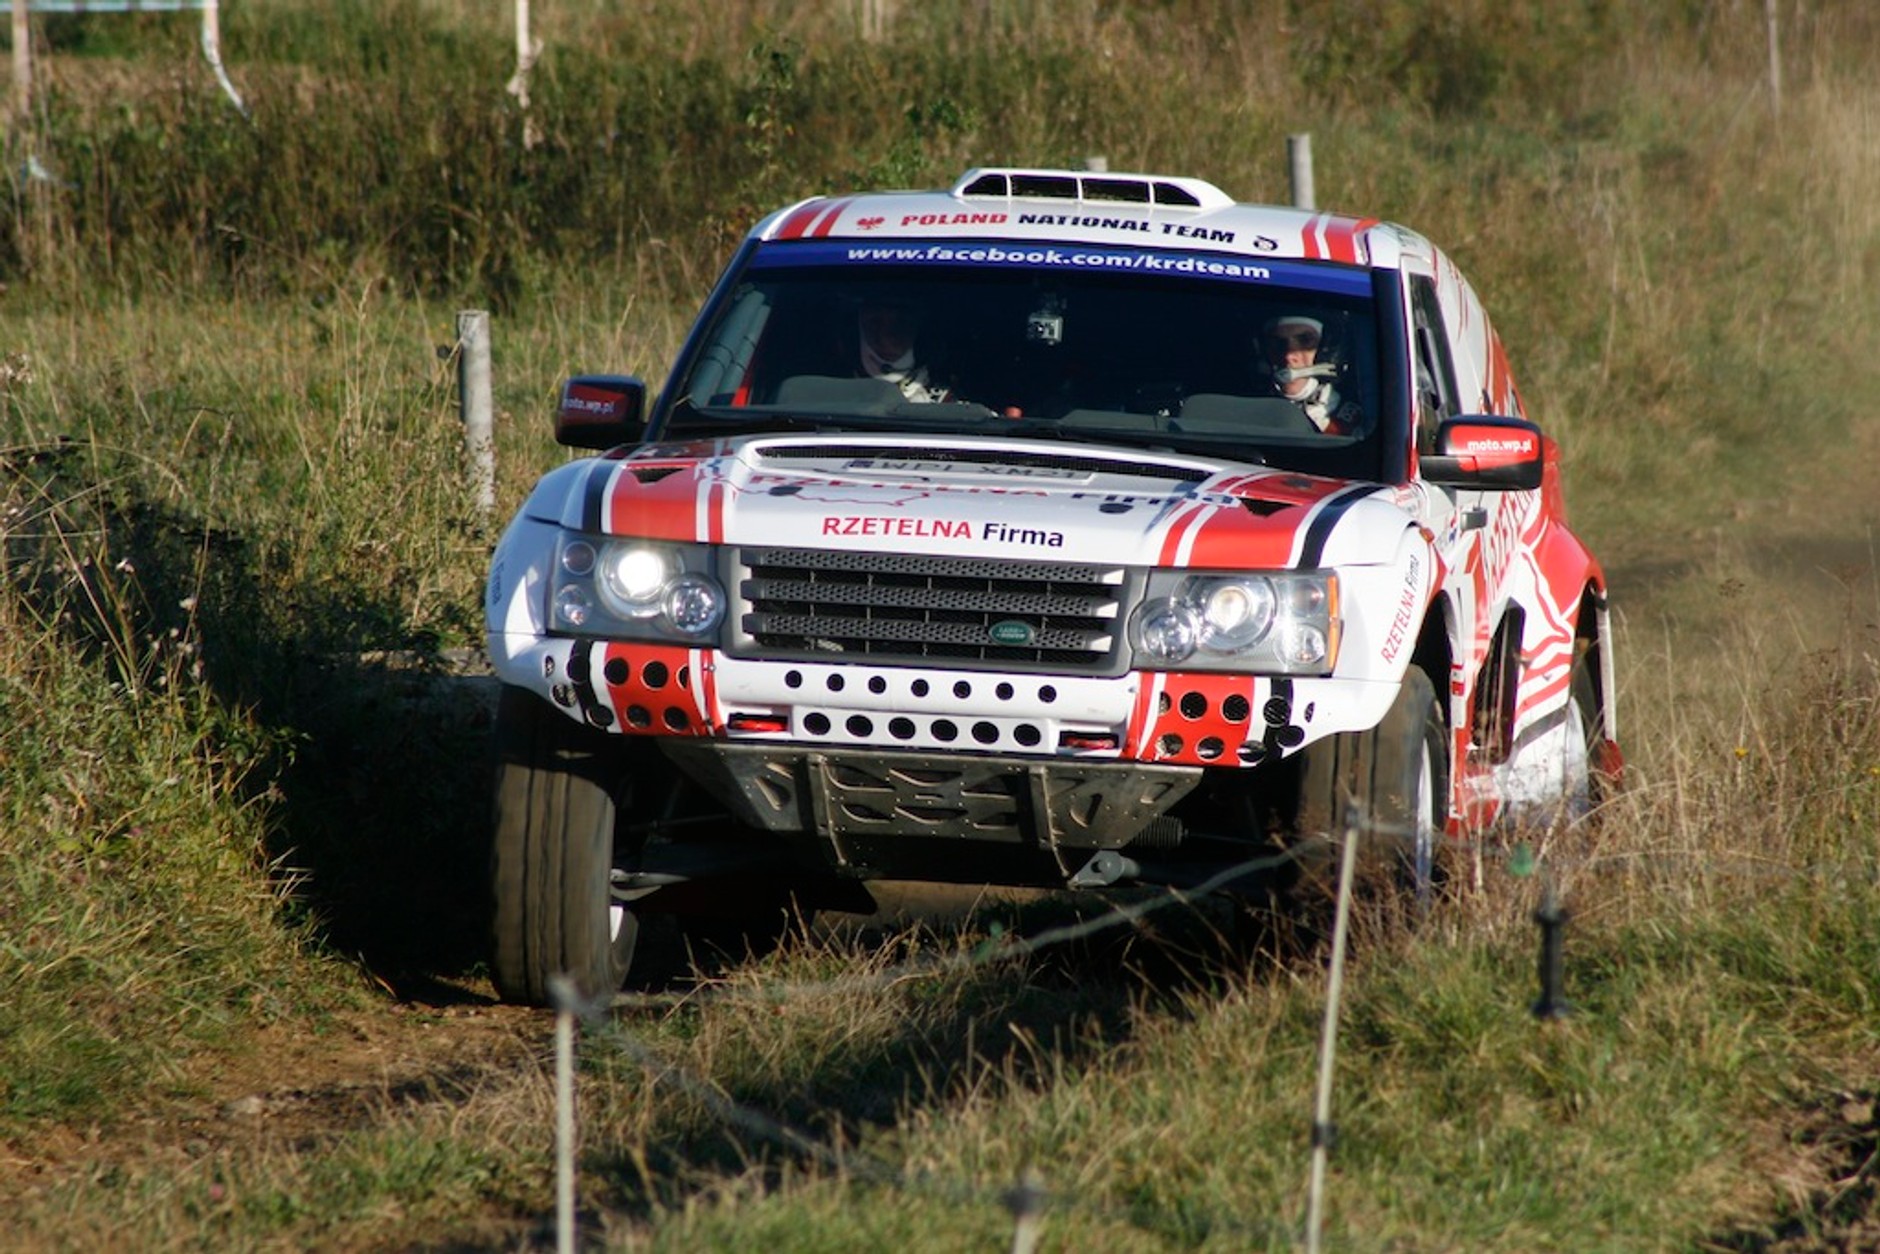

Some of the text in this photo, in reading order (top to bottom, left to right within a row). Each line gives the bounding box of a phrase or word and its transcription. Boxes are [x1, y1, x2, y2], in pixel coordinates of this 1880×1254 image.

[901, 213, 1236, 243] POLAND NATIONAL TEAM
[847, 246, 1270, 279] www.facebook.com/krdteam
[1467, 438, 1533, 453] moto.wp.pl
[822, 516, 1064, 548] RZETELNA Firma
[1381, 588, 1416, 665] RZETELNA
